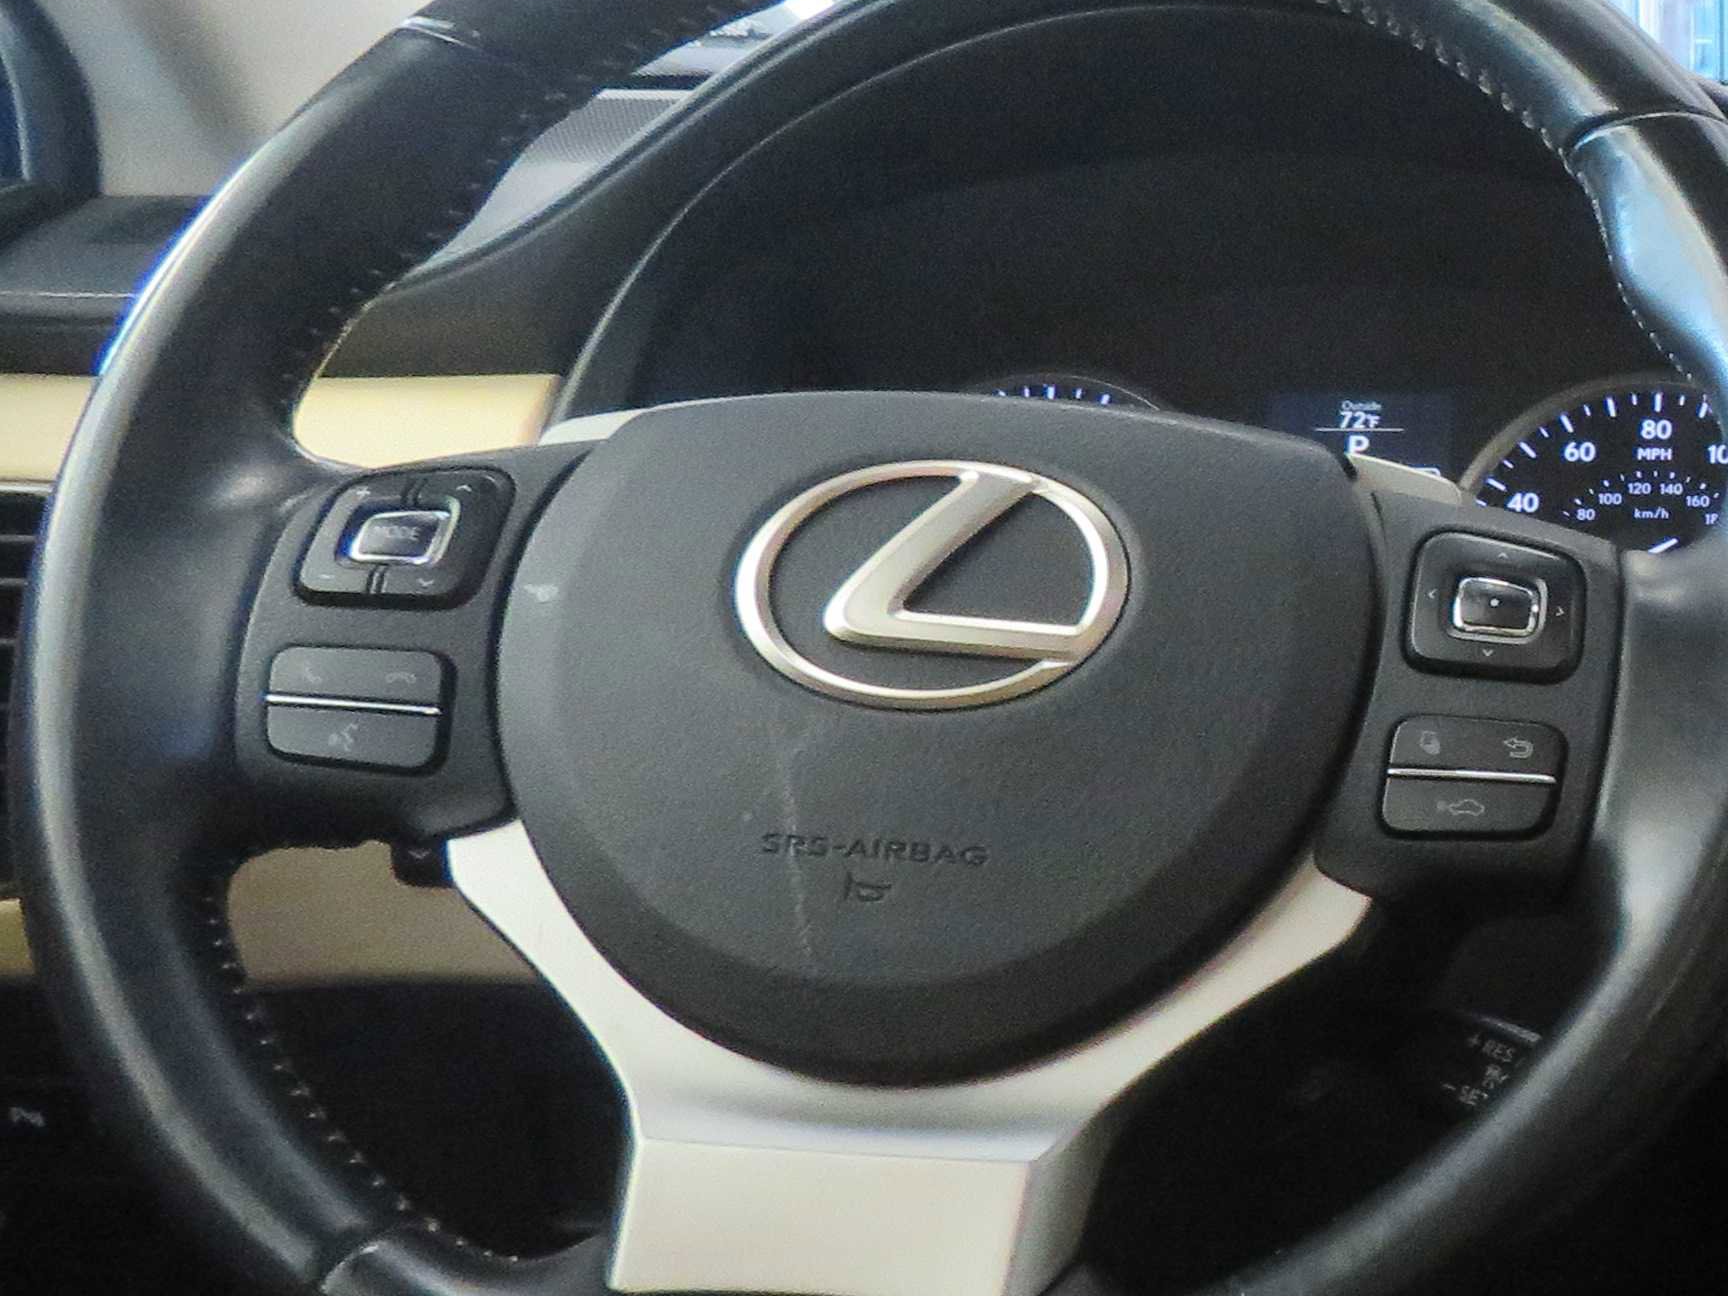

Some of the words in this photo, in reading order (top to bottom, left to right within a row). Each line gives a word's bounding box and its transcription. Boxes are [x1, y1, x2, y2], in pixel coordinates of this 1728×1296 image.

[1640, 419, 1673, 440] 80
[1348, 435, 1370, 454] P
[1563, 442, 1597, 463] 60
[1637, 447, 1673, 461] MPH
[1628, 482, 1651, 495] 120
[1660, 483, 1684, 495] 140
[1507, 492, 1540, 513] 40
[1598, 493, 1622, 505] 100
[1685, 495, 1710, 508] 160
[1576, 509, 1596, 521] 80
[1634, 507, 1670, 520] km/h
[761, 832, 990, 867] SRS-AIRBAG
